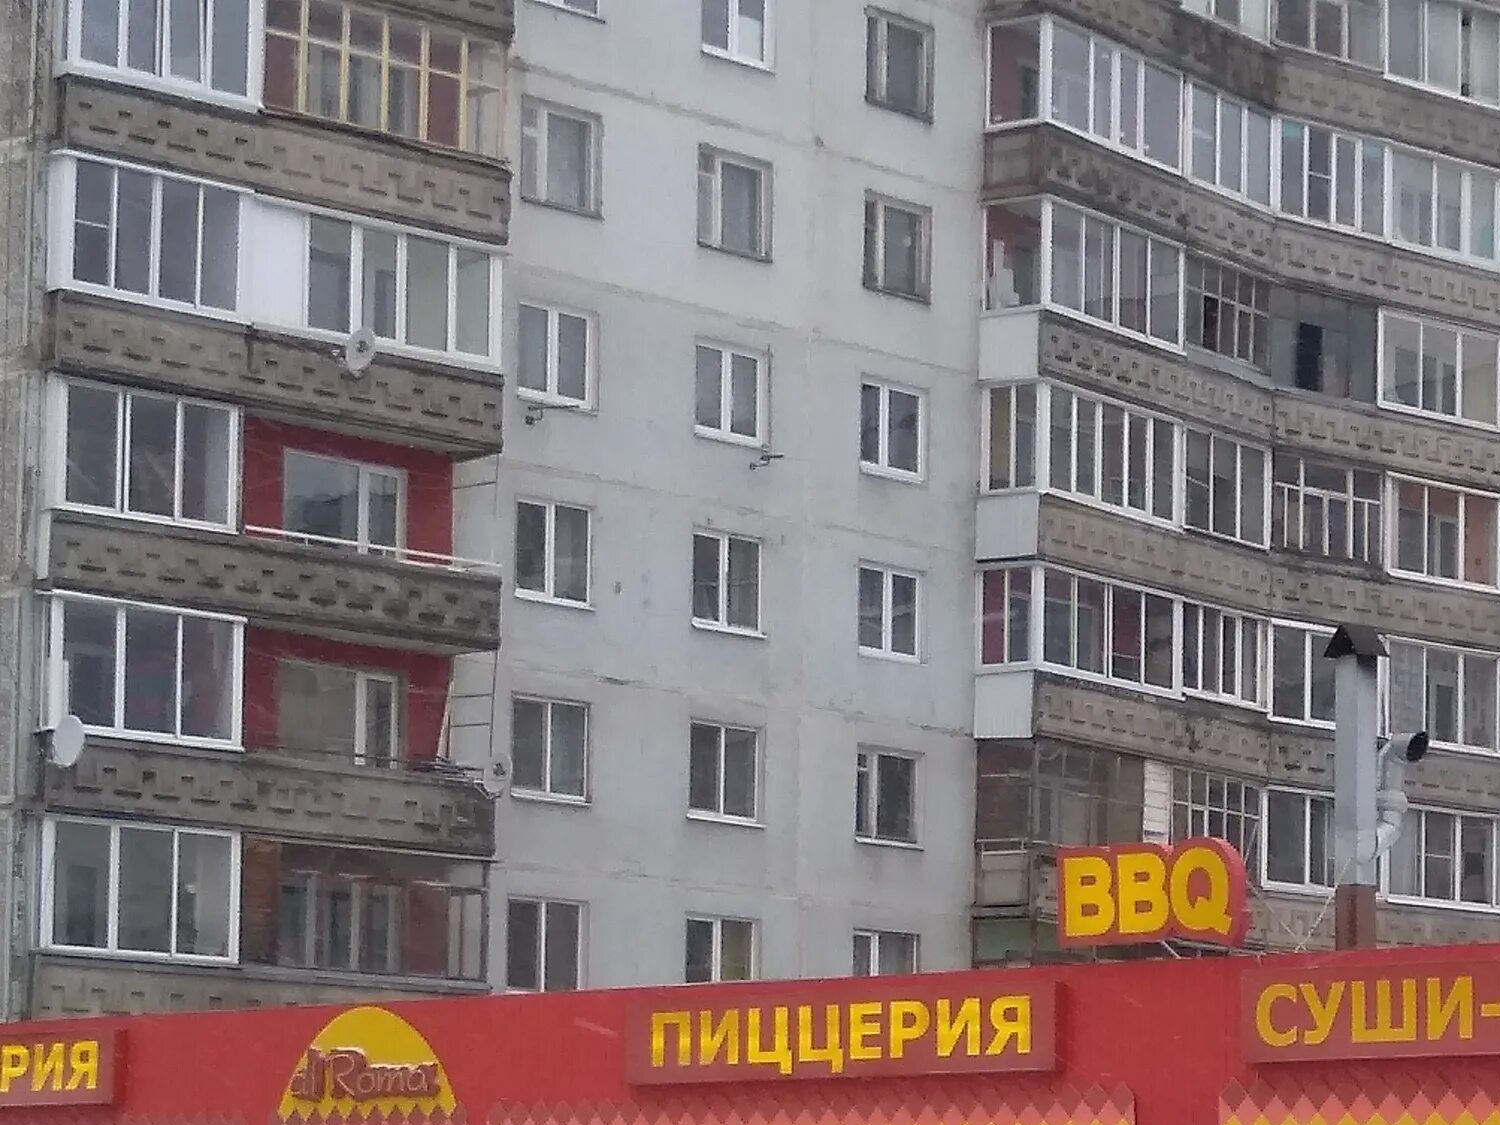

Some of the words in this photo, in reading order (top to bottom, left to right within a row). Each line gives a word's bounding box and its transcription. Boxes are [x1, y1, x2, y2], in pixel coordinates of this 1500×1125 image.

[1064, 846, 1233, 937] BBQ
[0, 1040, 98, 1092] РИЯ
[650, 994, 1033, 1075] ПИЦЦЕРИЯ
[325, 1054, 428, 1096] Roma
